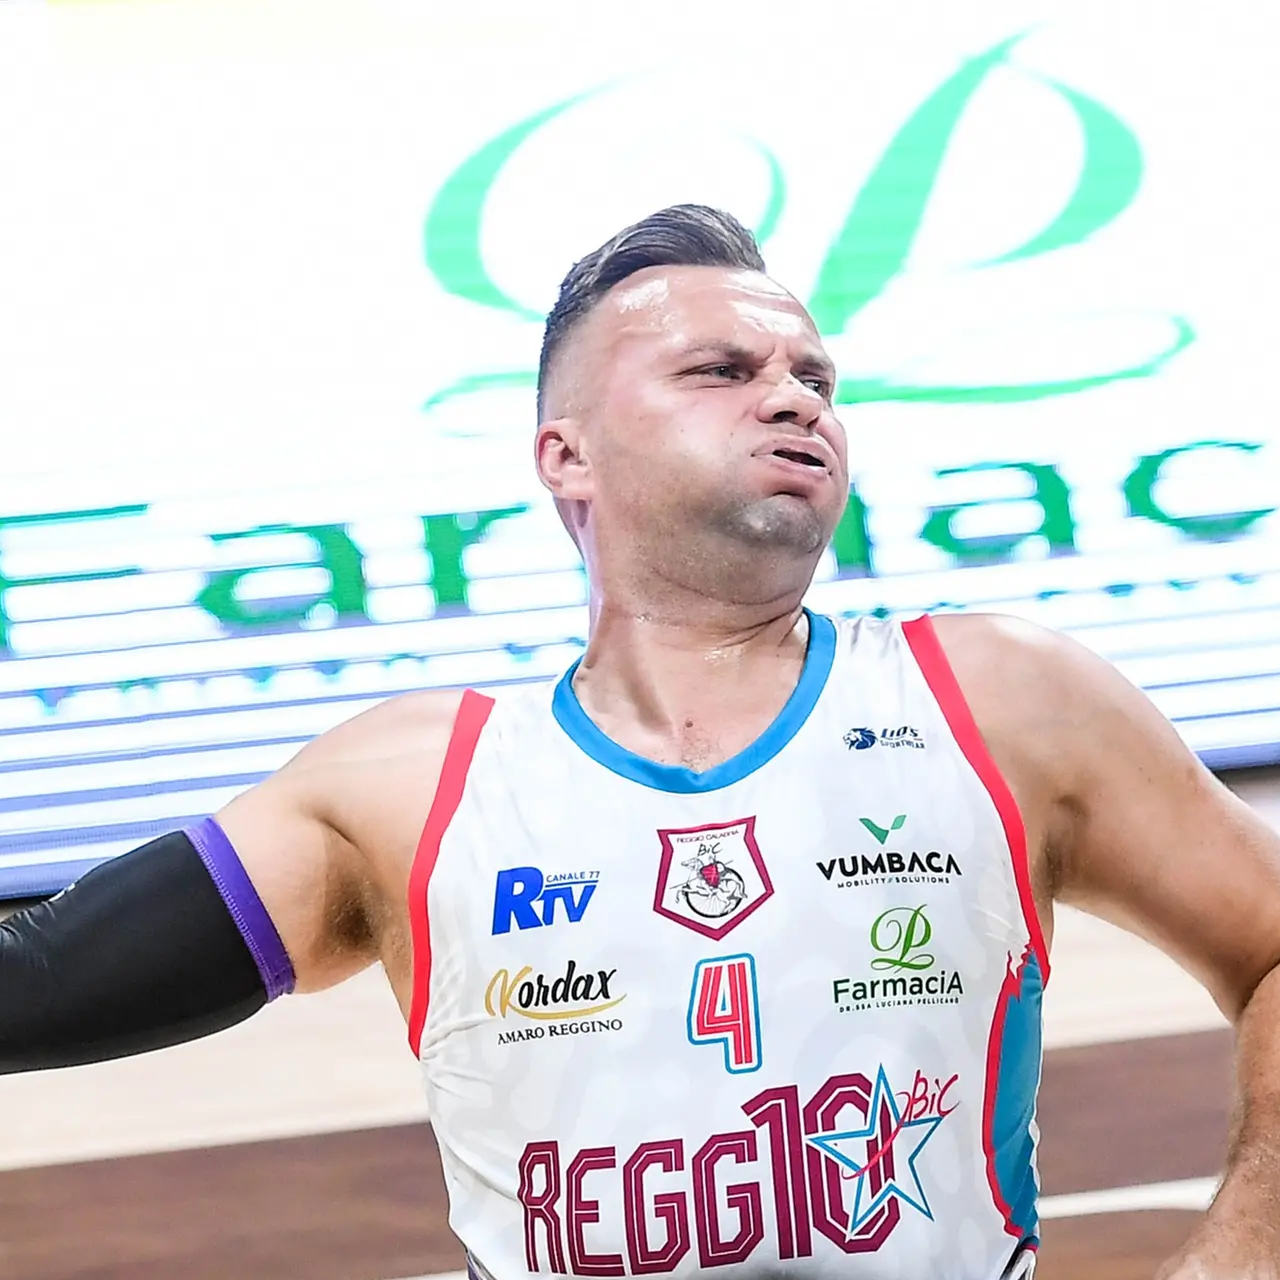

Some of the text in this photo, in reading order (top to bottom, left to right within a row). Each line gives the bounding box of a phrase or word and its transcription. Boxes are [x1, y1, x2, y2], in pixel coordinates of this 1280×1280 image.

[546, 870, 600, 883] CANALE 77
[816, 851, 962, 881] VUMBACA
[485, 960, 621, 1019] Kordax
[833, 970, 963, 1004] FarmaciA
[688, 953, 762, 1074] 4
[876, 999, 913, 1008] LUCIANA
[498, 1018, 623, 1046] AMARO REGGINO
